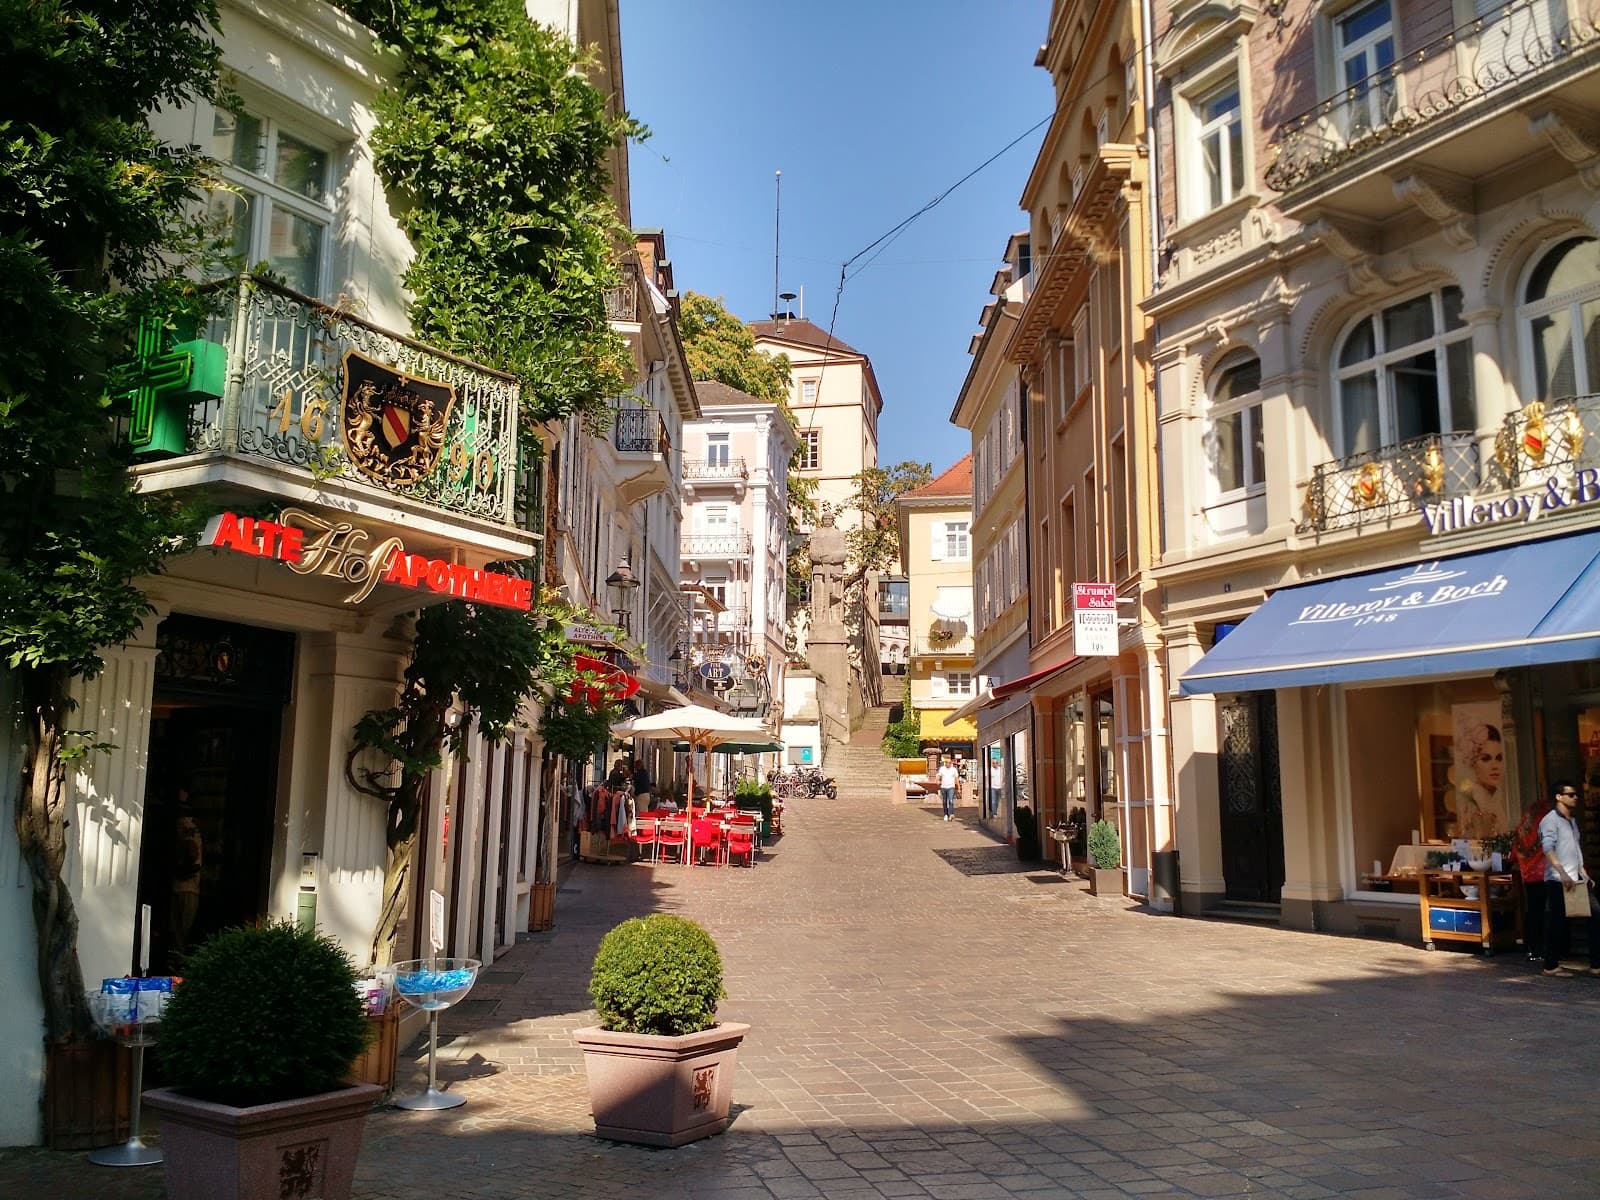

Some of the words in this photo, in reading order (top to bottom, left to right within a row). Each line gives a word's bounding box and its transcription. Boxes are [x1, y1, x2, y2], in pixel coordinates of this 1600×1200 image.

[270, 389, 324, 441] 16
[450, 441, 494, 490] 90
[1422, 491, 1541, 532] Villeroy
[1543, 476, 1569, 510] &
[213, 511, 304, 564] ALTE
[280, 507, 404, 604] Hof
[383, 548, 534, 611] APOTHEKE
[1077, 585, 1115, 598] Strumpf
[1088, 597, 1115, 608] Salon
[1298, 595, 1402, 621] Villeroy
[1401, 591, 1425, 606] &
[1430, 574, 1509, 604] Boch
[1354, 613, 1399, 627] 1748
[707, 667, 725, 678] ART
